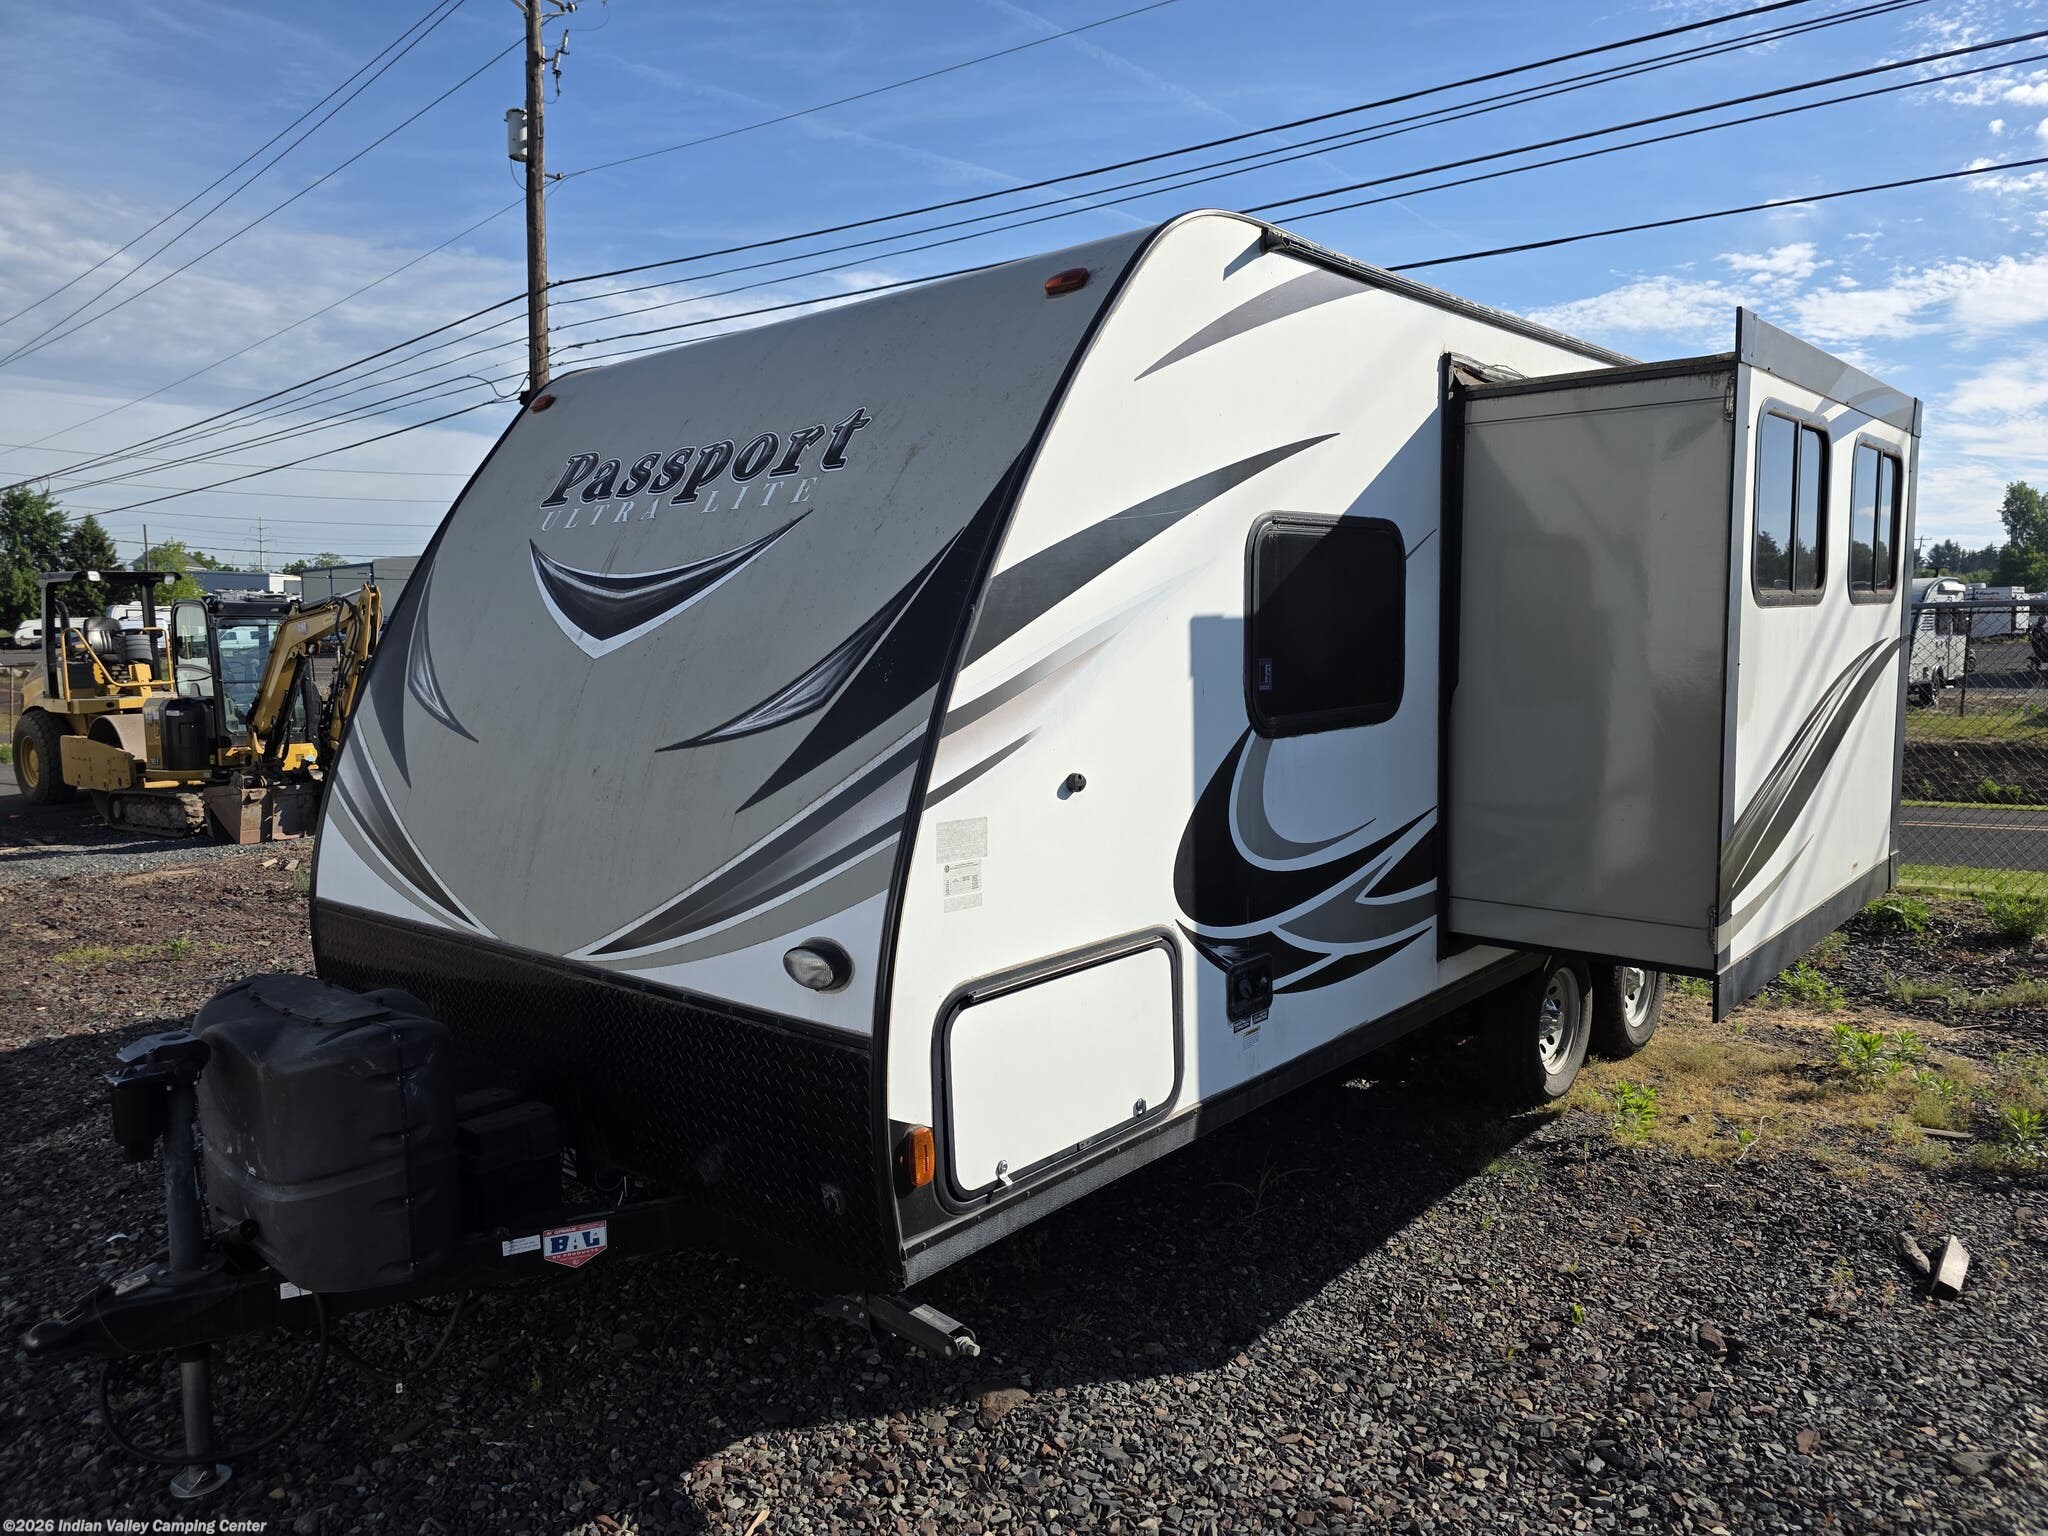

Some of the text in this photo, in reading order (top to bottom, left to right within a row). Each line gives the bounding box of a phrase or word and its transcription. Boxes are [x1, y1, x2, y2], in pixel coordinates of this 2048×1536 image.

[540, 406, 872, 509] Passport
[541, 476, 818, 532] ULTRA LITE
[550, 1231, 600, 1254] BAL
